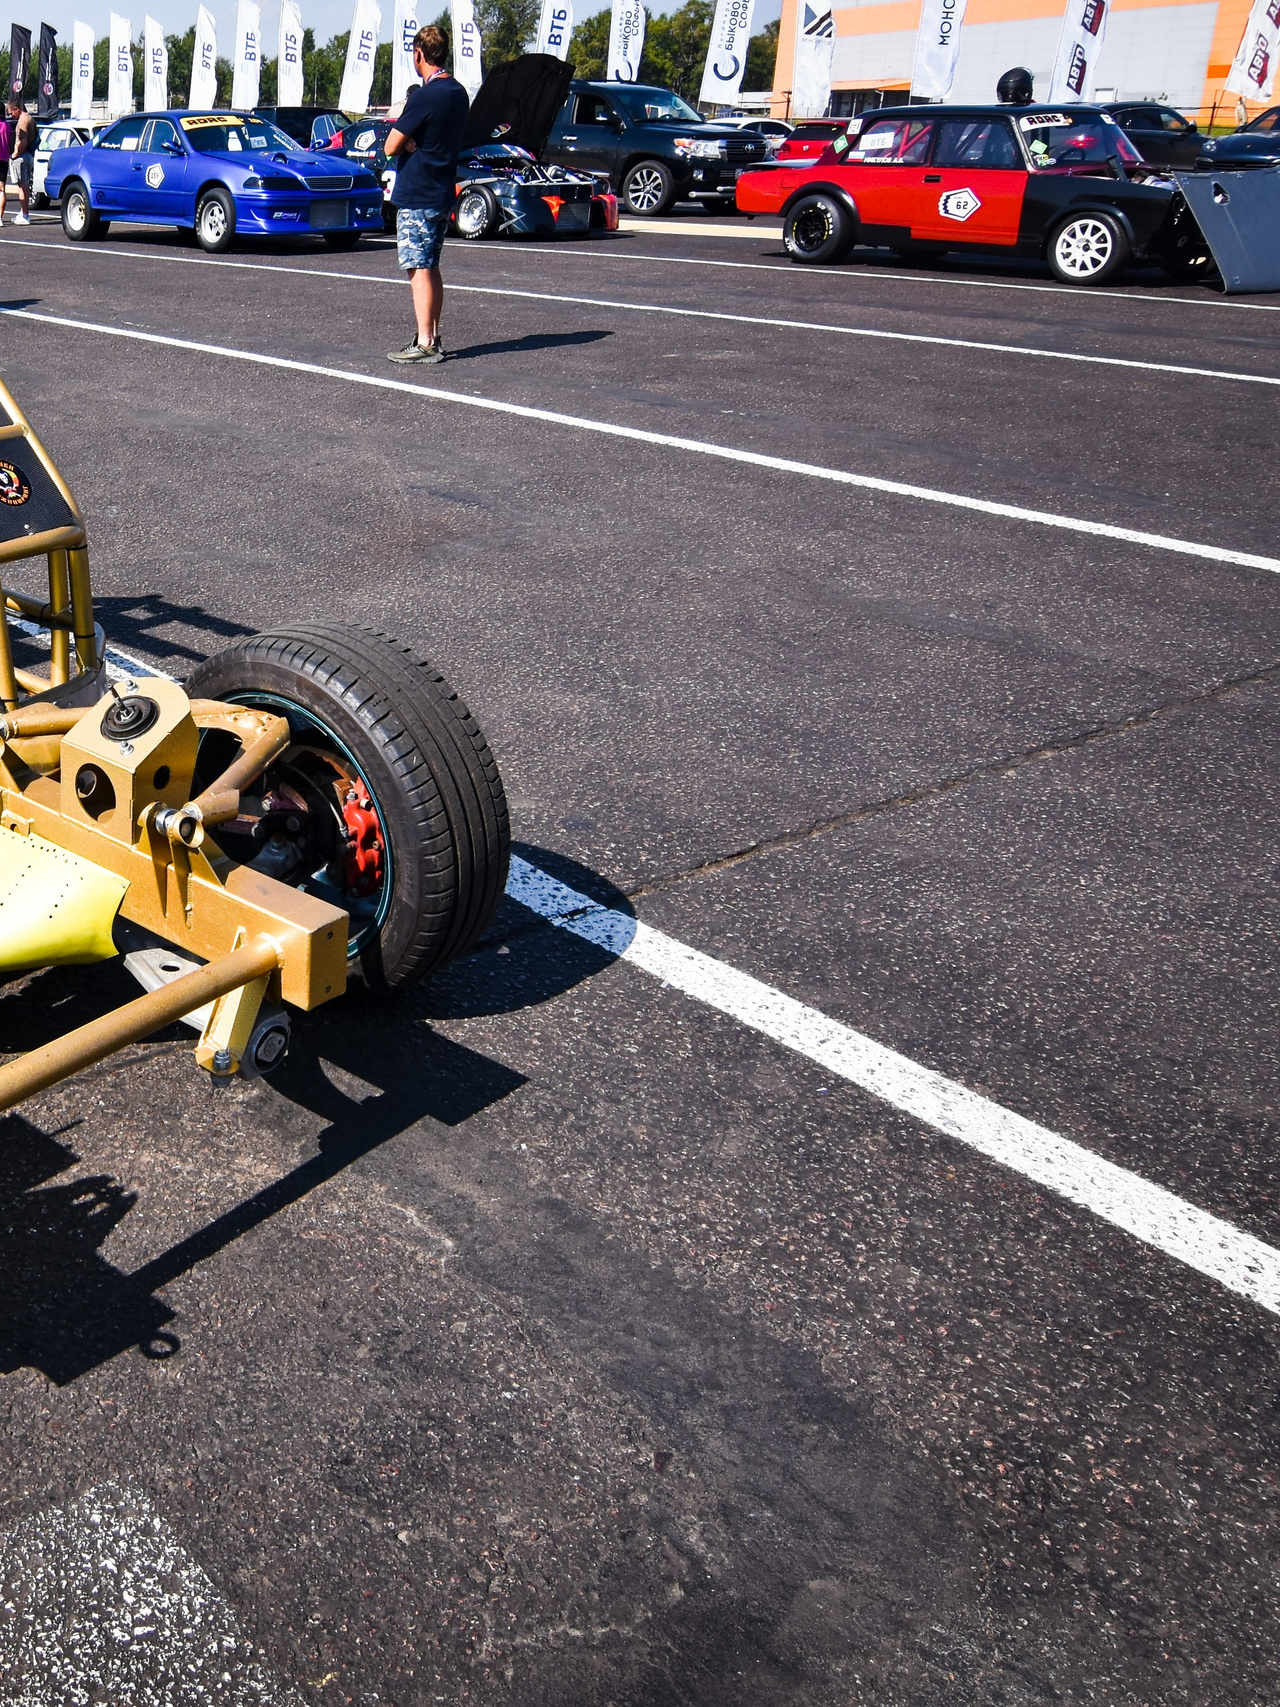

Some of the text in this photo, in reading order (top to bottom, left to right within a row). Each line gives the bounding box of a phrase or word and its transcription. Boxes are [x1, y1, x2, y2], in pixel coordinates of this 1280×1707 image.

[403, 19, 417, 52] ВТБ
[461, 22, 474, 58] ВТБ
[548, 9, 567, 46] ВТБ
[622, 10, 633, 57] БЫКОВО
[725, 1, 741, 51] БЫКОВО
[118, 45, 128, 72] ВТБ
[153, 47, 163, 75] ВТБ
[202, 42, 213, 70] ВТБ
[245, 31, 256, 61] ВТБ
[286, 33, 297, 63] ВТБ
[358, 30, 373, 62] ВТБ
[80, 52, 90, 77] ВТБ
[1069, 45, 1086, 90] АВТО
[185, 116, 228, 126] RDRC
[1026, 113, 1061, 126] RDRC
[956, 201, 969, 210] 62
